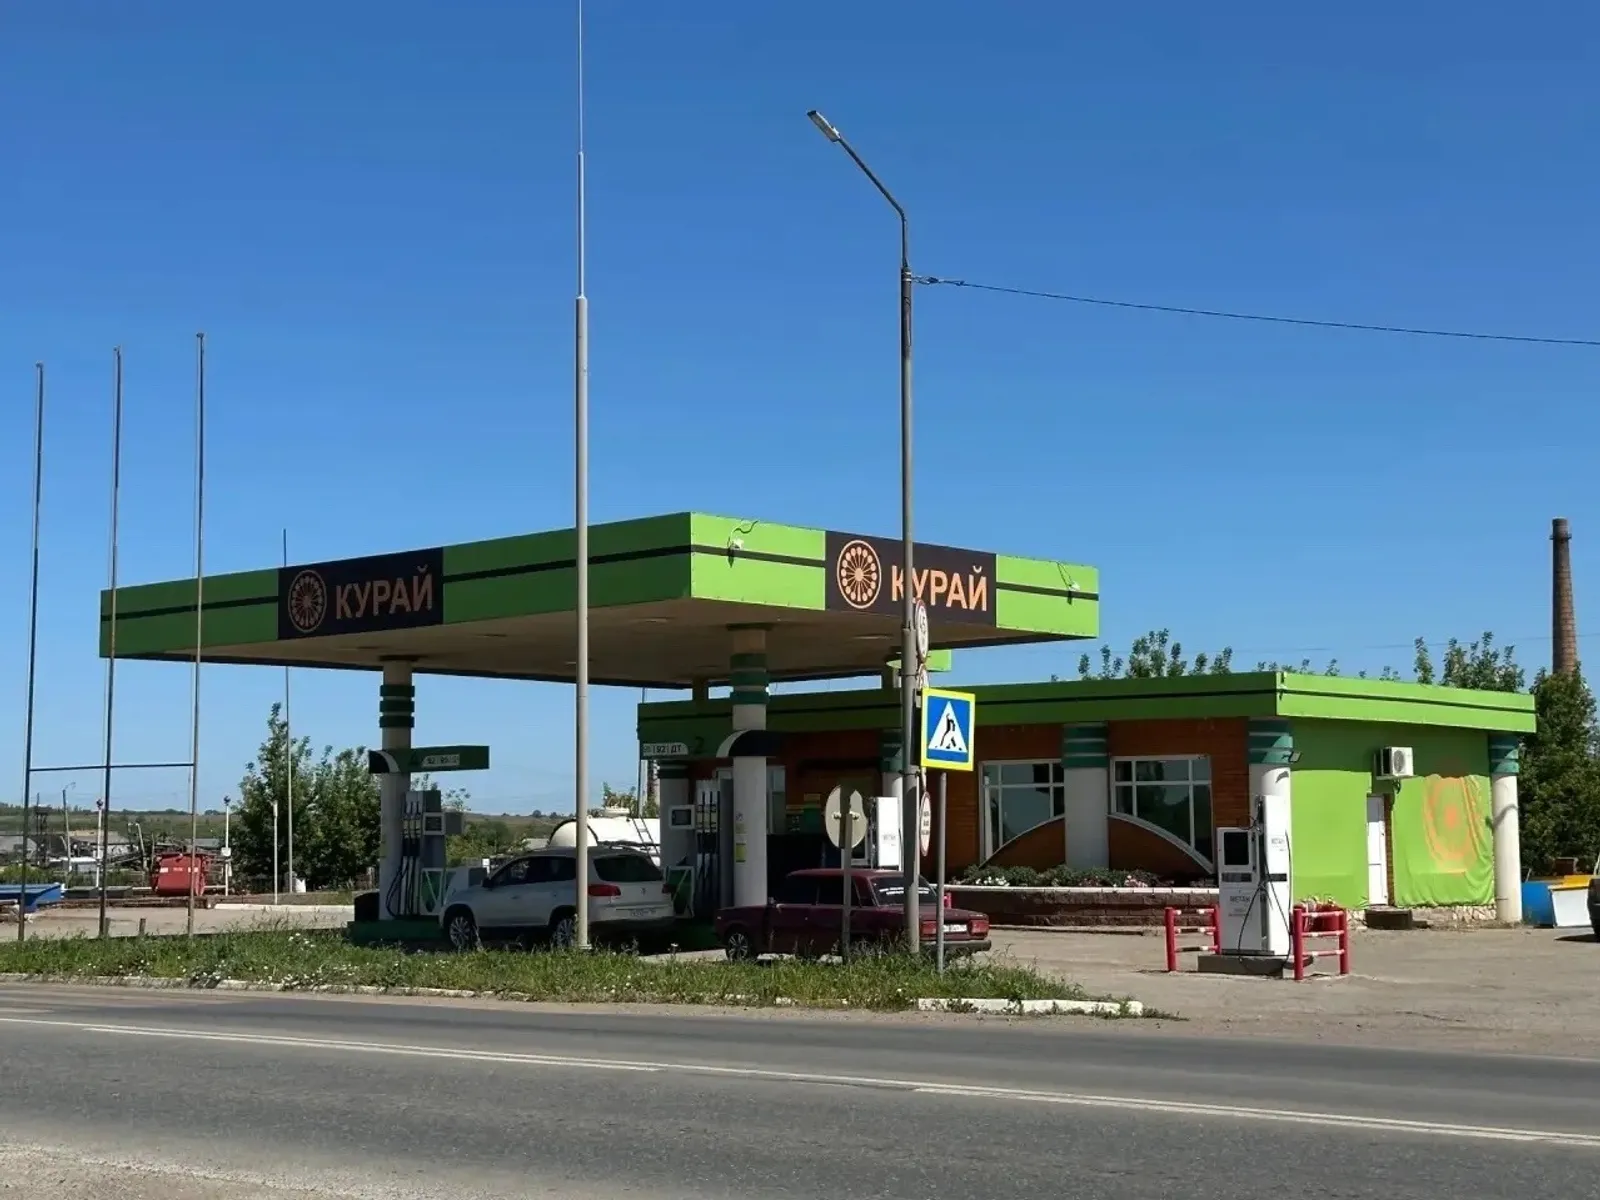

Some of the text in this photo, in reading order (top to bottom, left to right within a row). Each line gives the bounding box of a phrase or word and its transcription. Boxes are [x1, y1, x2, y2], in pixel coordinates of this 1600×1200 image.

[335, 564, 433, 620] КУРАЙ
[891, 565, 988, 612] КУРАЙ
[656, 745, 666, 753] 92
[670, 744, 682, 754] ДТ
